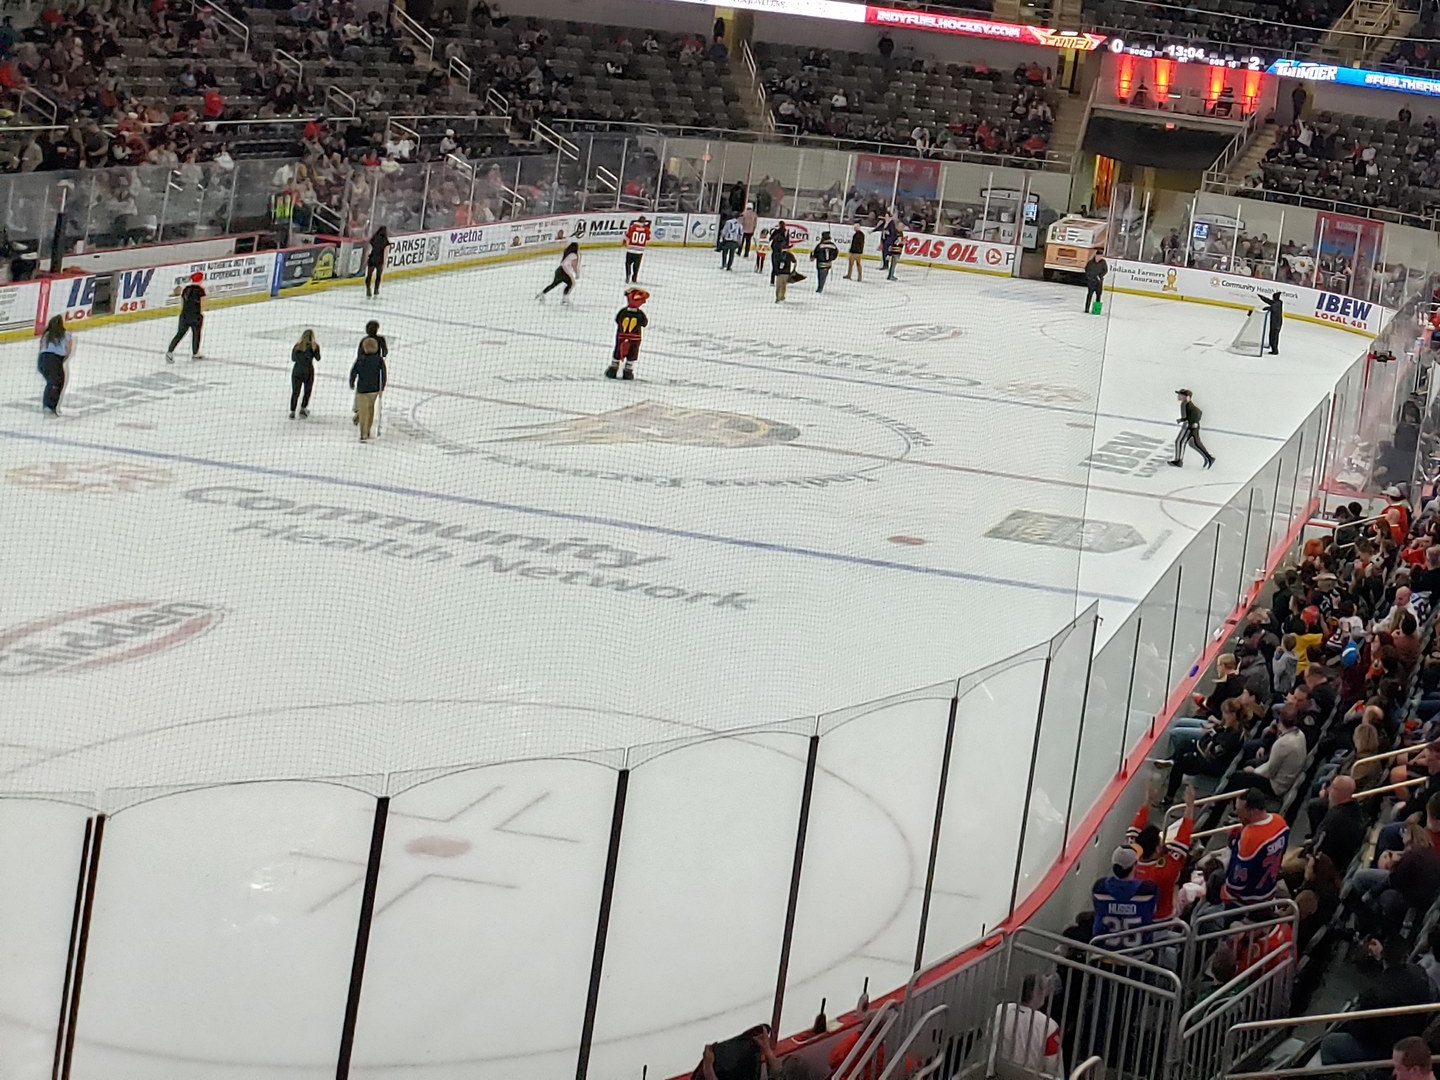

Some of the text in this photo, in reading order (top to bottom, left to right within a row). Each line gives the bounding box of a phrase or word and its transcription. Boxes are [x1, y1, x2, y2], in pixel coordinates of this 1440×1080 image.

[876, 10, 1021, 39] INDYFUELHOCKEY.COM
[1111, 38, 1124, 54] 0
[1168, 44, 1205, 60] 13:04
[1248, 56, 1260, 71] 2
[1275, 61, 1338, 81] THUNDER
[457, 229, 483, 244] aetna
[947, 242, 979, 264] OIL
[1109, 264, 1166, 278] Indiana Farmers
[1131, 275, 1165, 285] Insurance
[1221, 280, 1256, 292] Community
[1316, 292, 1372, 321] IBEW
[1314, 311, 1368, 330] LOCAL 481
[182, 484, 672, 570] Community
[232, 518, 758, 613] Health Network
